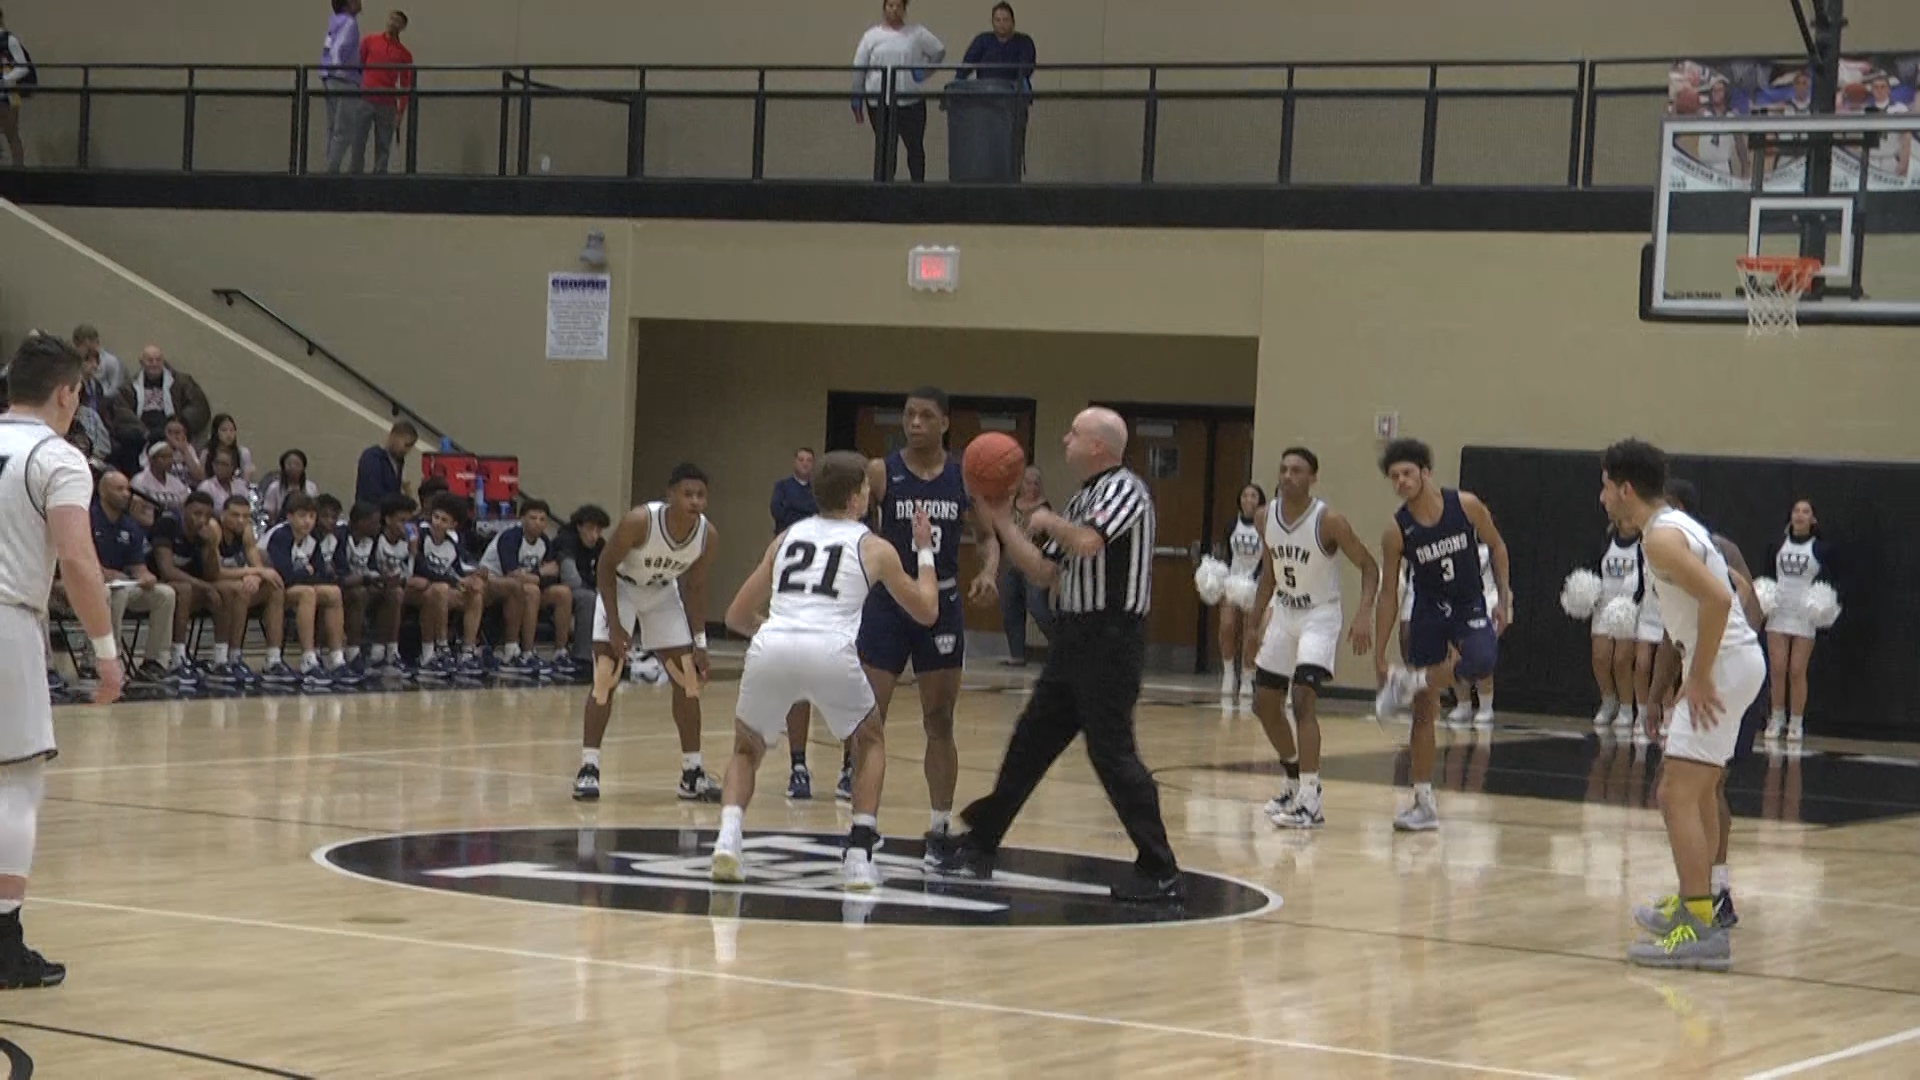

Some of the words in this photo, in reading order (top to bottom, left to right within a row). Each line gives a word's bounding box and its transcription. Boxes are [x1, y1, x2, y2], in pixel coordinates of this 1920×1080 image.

[1271, 545, 1310, 565] SOUTH
[1415, 532, 1468, 565] DRAGONS
[778, 541, 843, 599] 21
[1283, 566, 1296, 588] 5
[1440, 557, 1455, 581] 3
